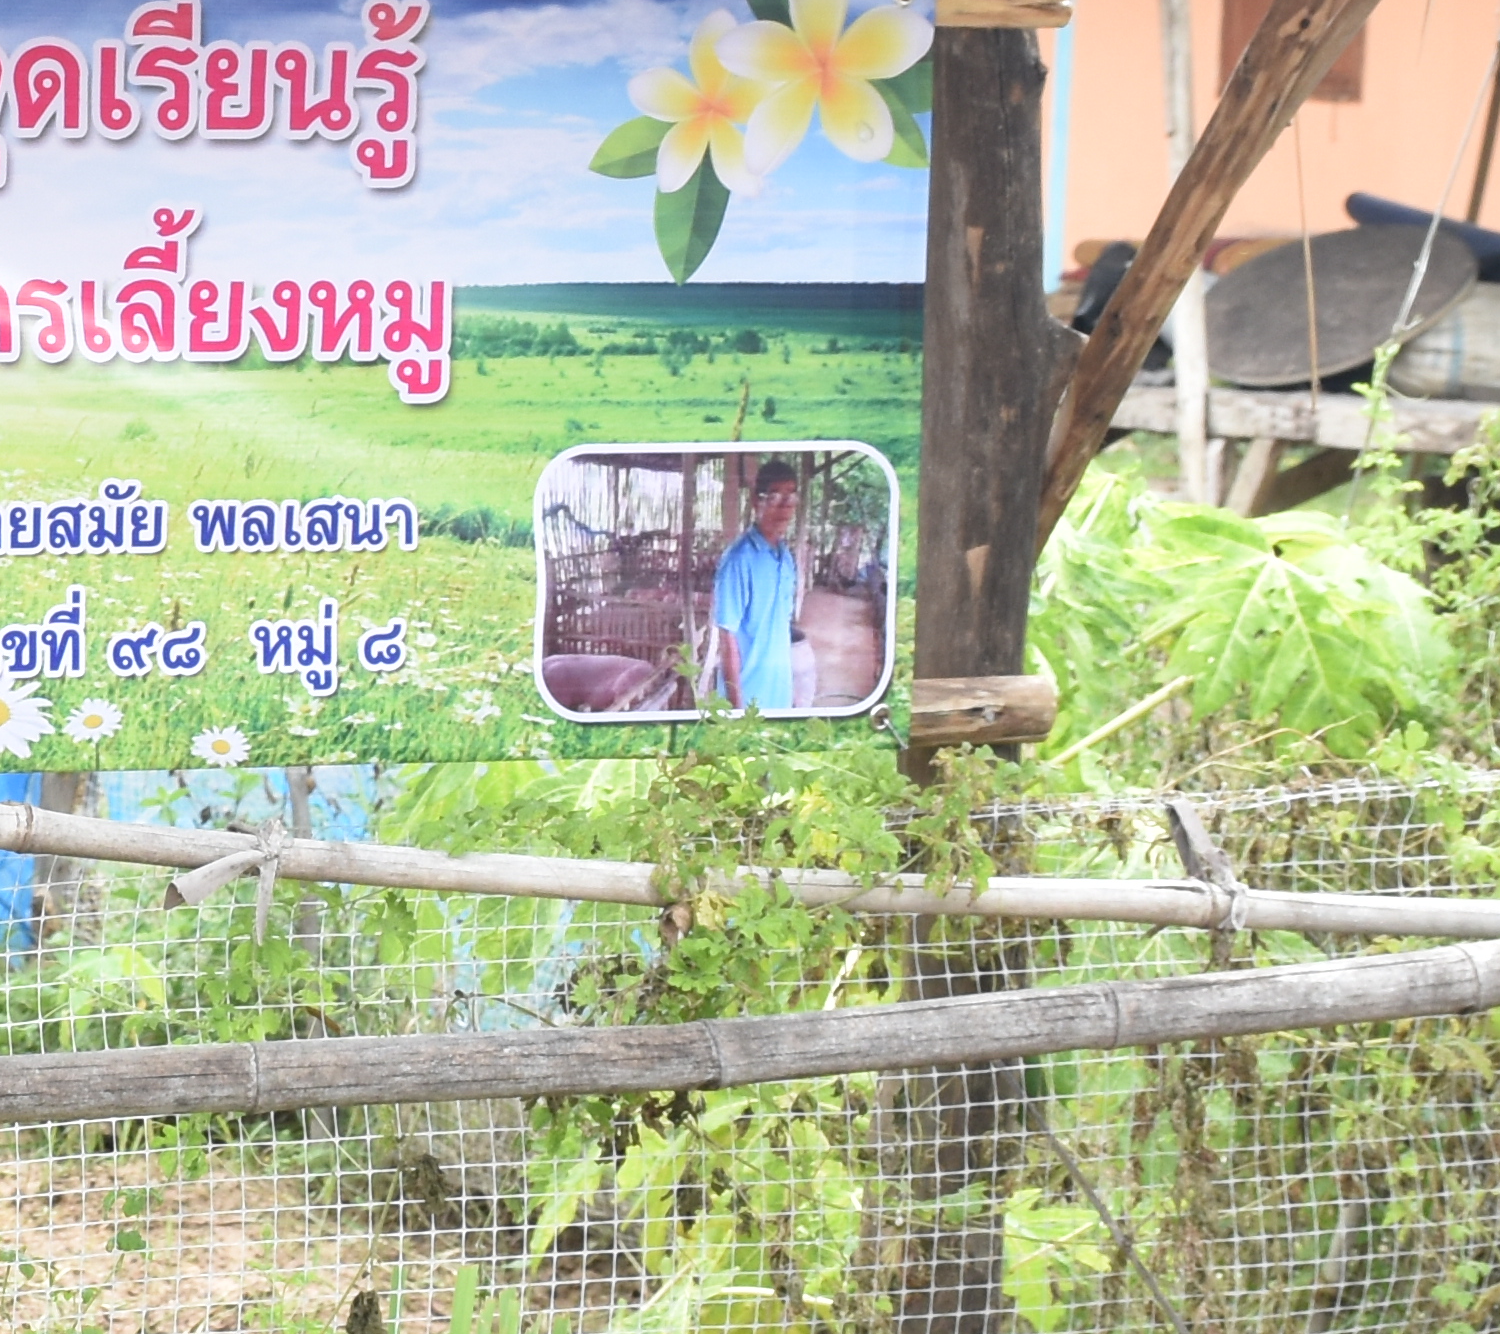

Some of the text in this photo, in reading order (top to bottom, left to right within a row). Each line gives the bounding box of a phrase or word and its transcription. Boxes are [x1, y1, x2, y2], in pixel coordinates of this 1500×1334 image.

[191, 498, 416, 549] พลเสนา
[111, 624, 203, 671] ๙๘
[252, 602, 334, 692] หมู่
[362, 622, 404, 667] ๘
